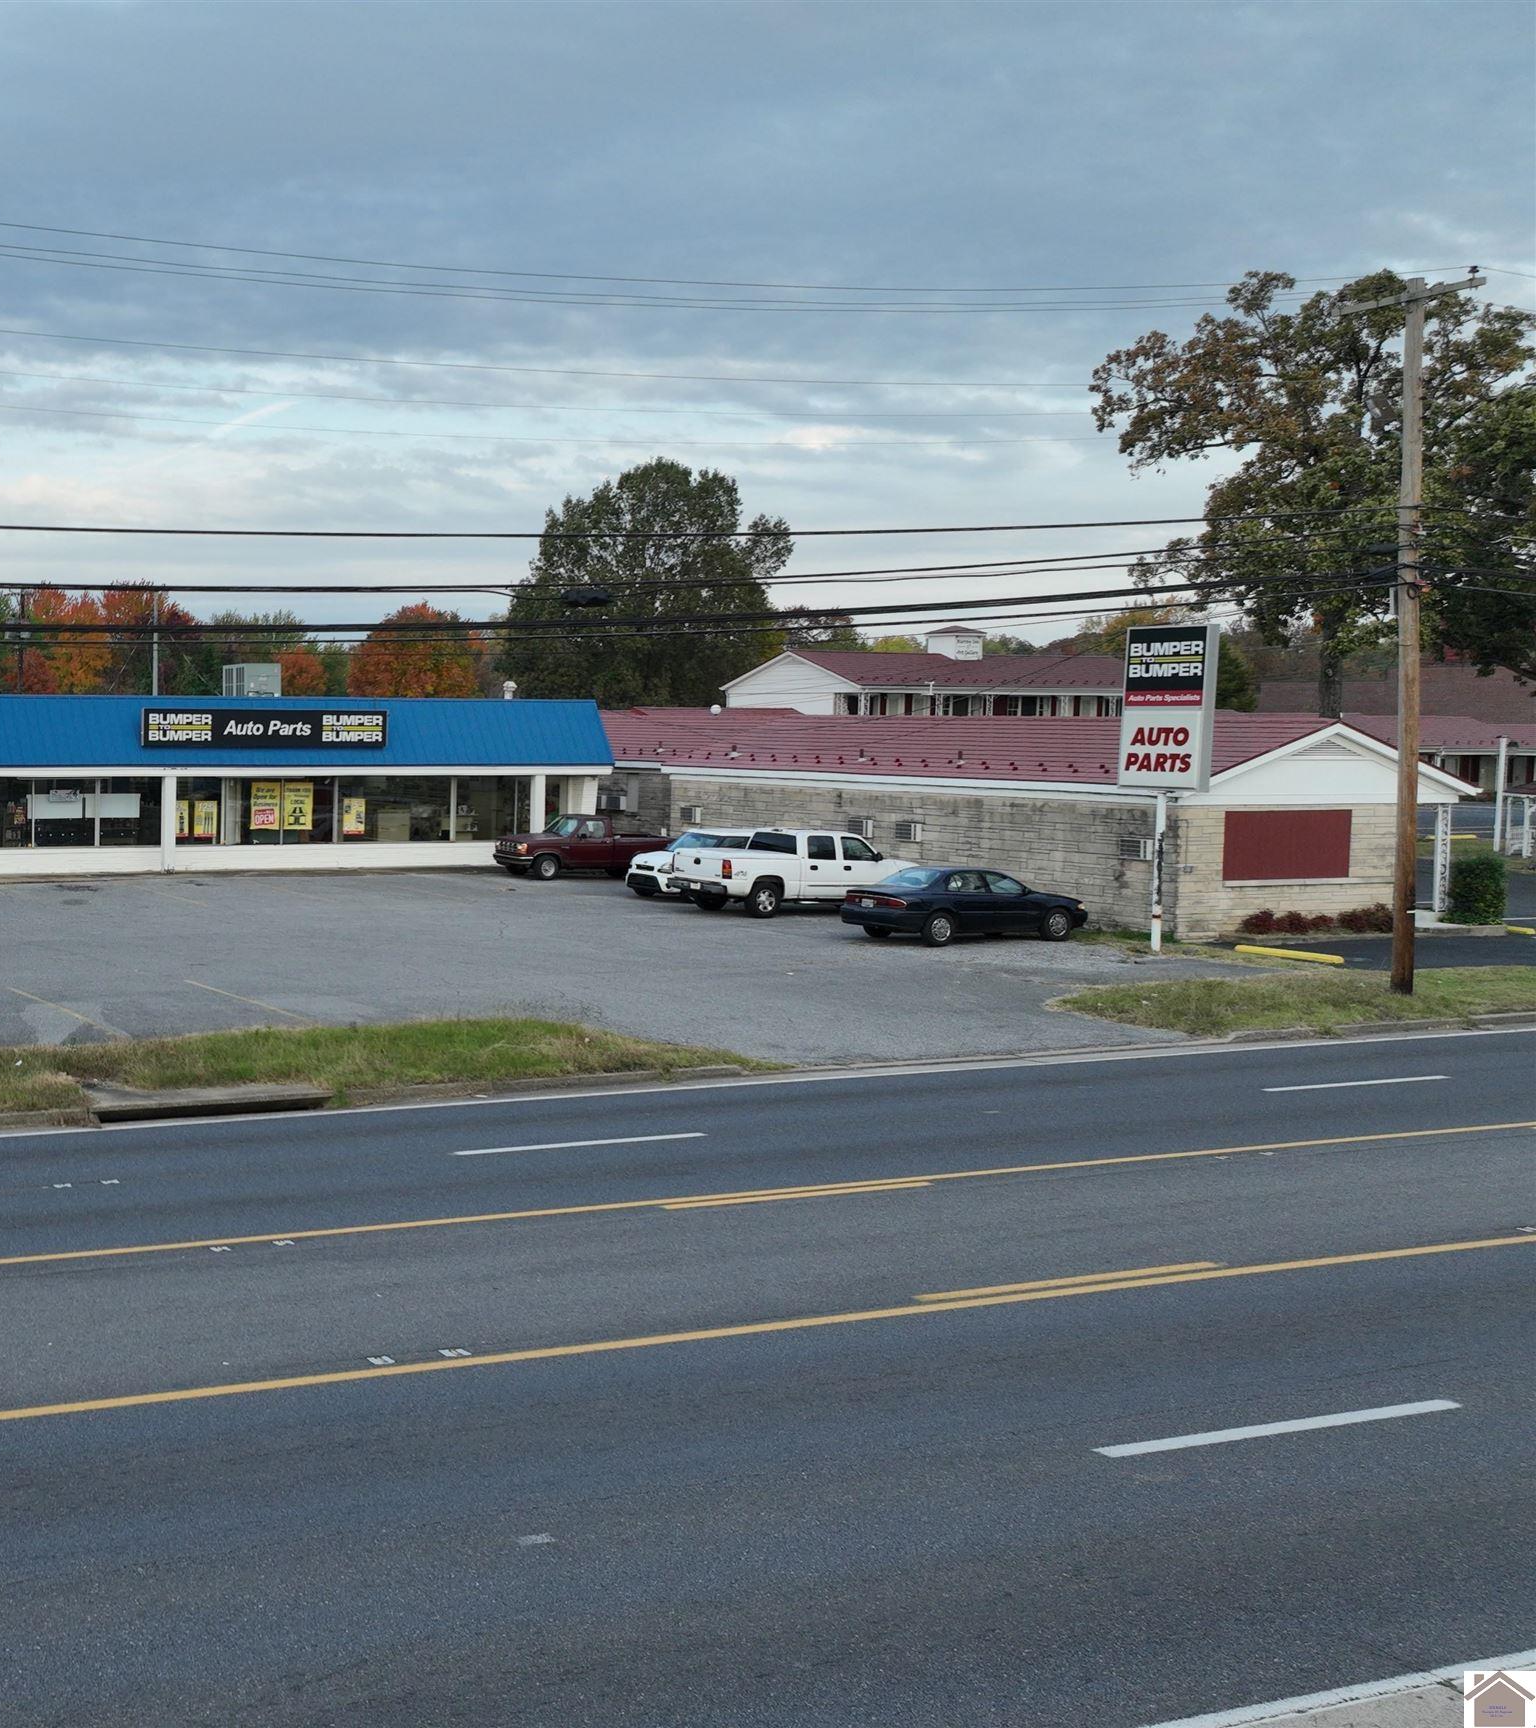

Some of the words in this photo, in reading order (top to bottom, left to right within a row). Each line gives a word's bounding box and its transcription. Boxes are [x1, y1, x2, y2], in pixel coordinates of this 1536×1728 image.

[1130, 641, 1204, 657] BUMPER
[1128, 663, 1202, 678] BUMPER
[1128, 694, 1144, 702] Auto
[1145, 694, 1163, 702] Parts
[1164, 693, 1201, 703] Specialists
[148, 713, 212, 725] BUMPER
[322, 714, 383, 726] BUMPER
[223, 719, 264, 736] Auto
[267, 719, 312, 736] Parts
[148, 730, 212, 741] BUMPER
[321, 731, 383, 742] BUMPER
[1130, 727, 1189, 746] AUTO
[1124, 752, 1192, 773] PARTS
[255, 813, 275, 825] OPEN
